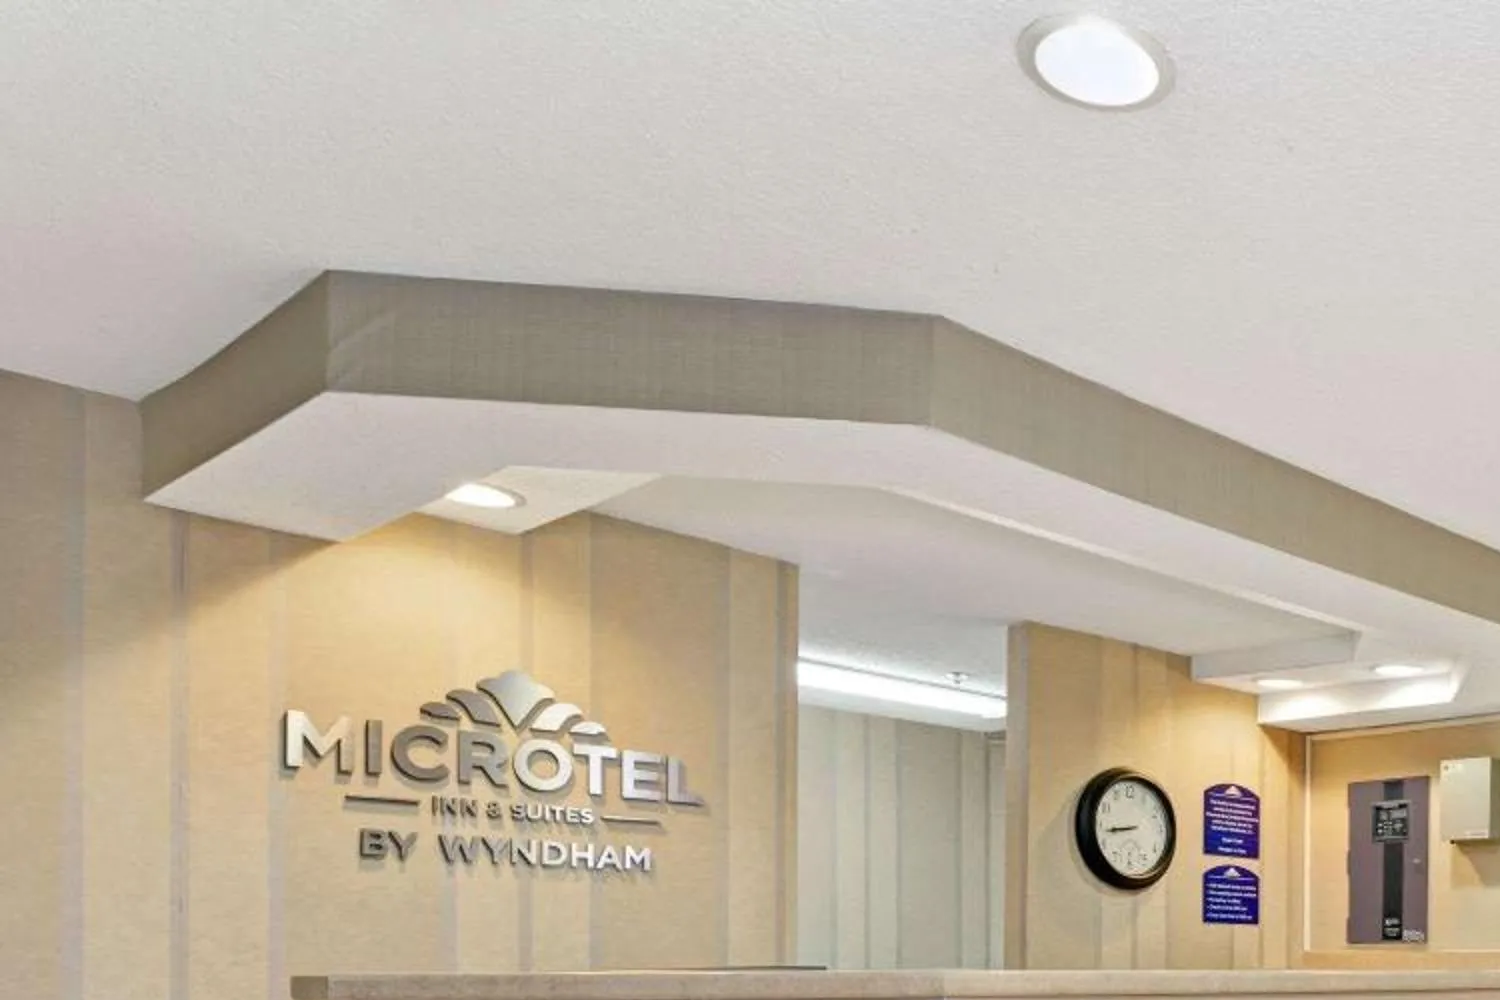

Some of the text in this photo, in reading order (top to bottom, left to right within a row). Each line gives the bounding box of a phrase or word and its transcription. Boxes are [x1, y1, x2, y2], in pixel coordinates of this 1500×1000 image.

[282, 709, 705, 806] MICROTEL
[431, 795, 596, 825] INN & SUITES
[359, 828, 653, 872] BY WYNDHAM
